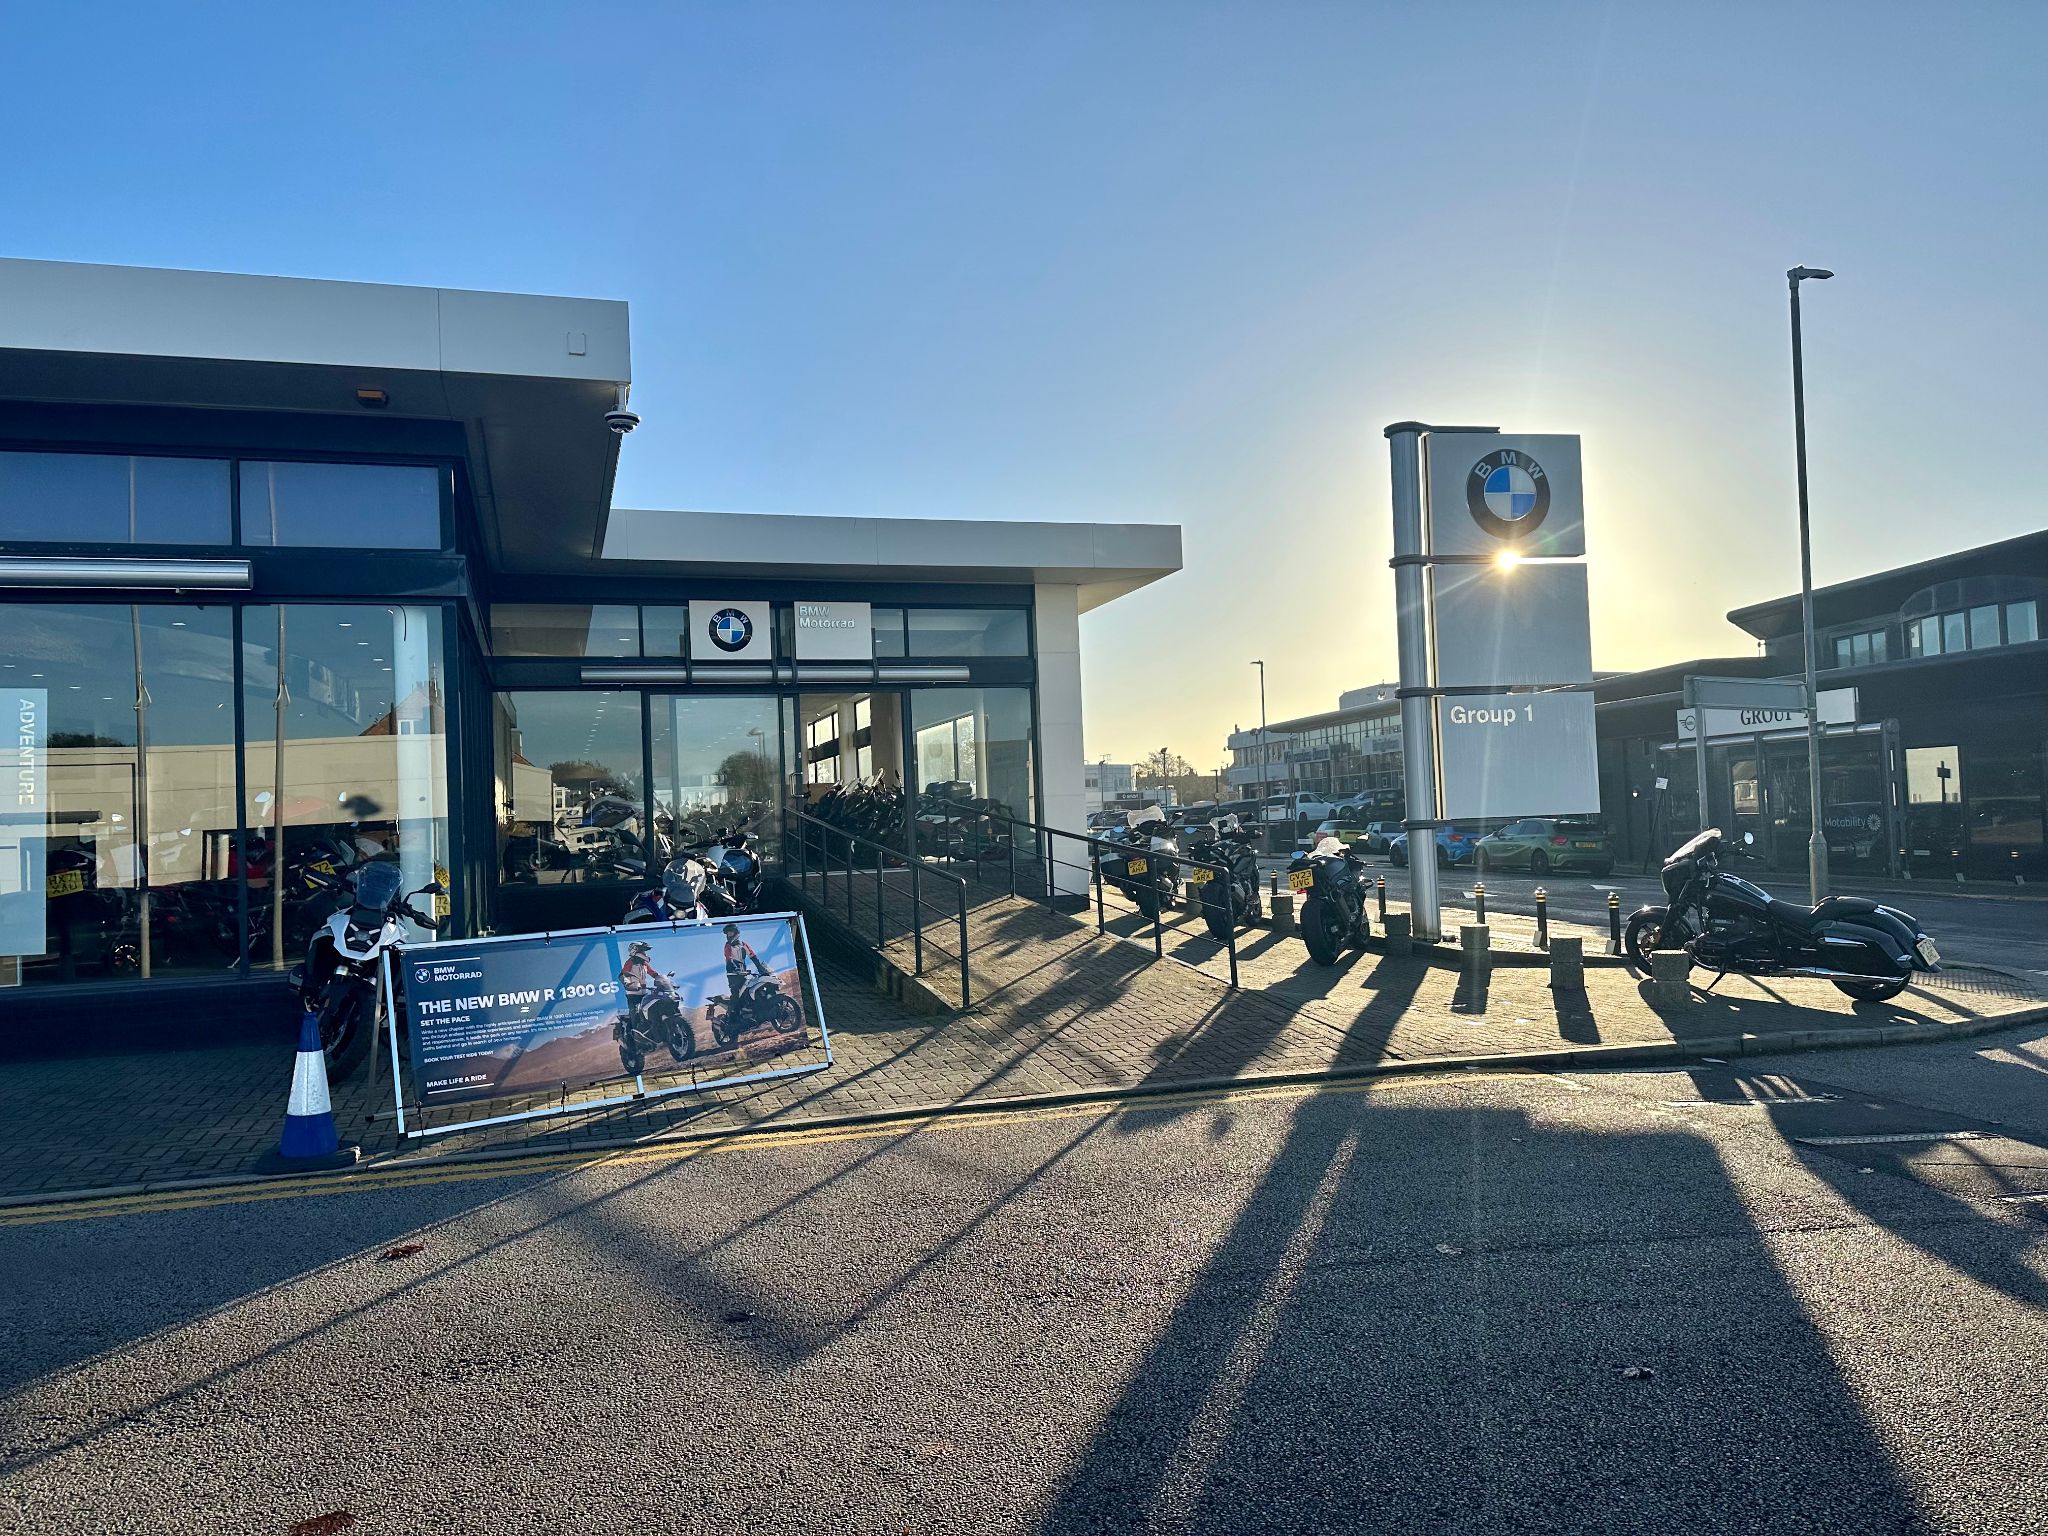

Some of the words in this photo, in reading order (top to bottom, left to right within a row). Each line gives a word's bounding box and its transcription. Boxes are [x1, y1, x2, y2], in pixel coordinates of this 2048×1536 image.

[1474, 451, 1544, 480] BMW
[713, 609, 749, 624] BMW
[799, 605, 830, 617] BMW
[799, 617, 856, 629] Motorrad
[1450, 705, 1517, 727] Group
[1523, 703, 1533, 722] 1
[18, 698, 35, 805] ADVENTURE
[1824, 816, 1866, 829] Motability
[1289, 870, 1312, 882] GV23
[433, 965, 456, 975] BMW
[434, 971, 483, 982] MOTORRAD
[418, 1000, 452, 1015] THE
[455, 994, 495, 1011] NEW
[498, 990, 541, 1007] BMW
[543, 988, 555, 1001] R
[559, 985, 597, 999] 1300
[598, 981, 621, 995] GS
[420, 1019, 435, 1027] SET
[435, 1017, 451, 1025] THE
[451, 1015, 471, 1023] PACE
[426, 1079, 448, 1088] MAKE
[448, 1077, 464, 1085] LIFE
[470, 1073, 487, 1082] RIDE
